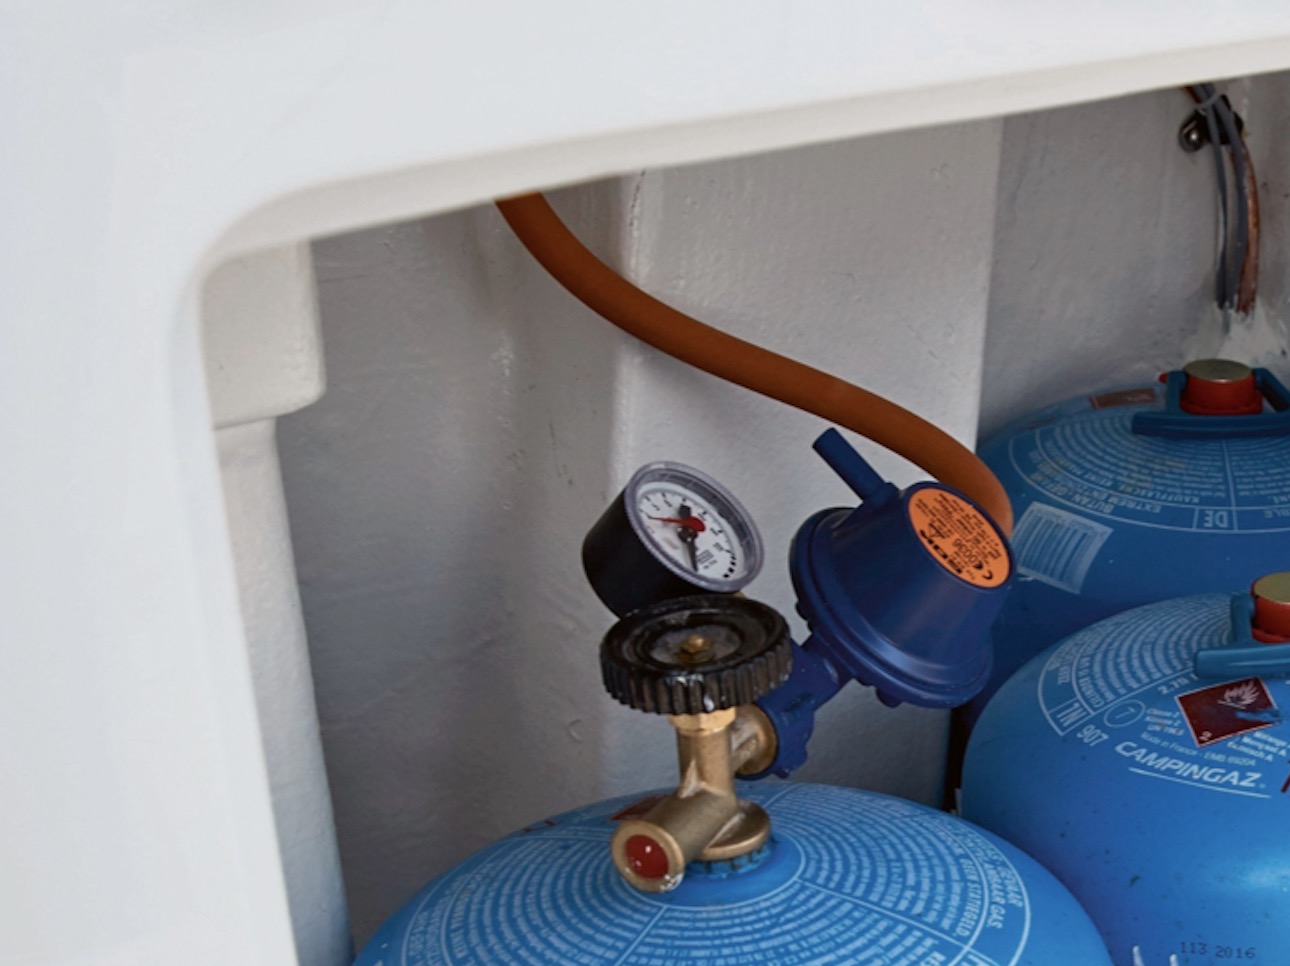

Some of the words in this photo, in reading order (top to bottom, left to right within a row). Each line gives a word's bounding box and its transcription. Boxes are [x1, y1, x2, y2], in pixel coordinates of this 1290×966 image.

[1203, 510, 1230, 528] DE
[1055, 702, 1088, 728] NL
[1076, 724, 1109, 747] 907
[1114, 740, 1262, 788] CAMPINGAZ
[1180, 941, 1207, 955] 113
[1215, 945, 1256, 959] 2016
